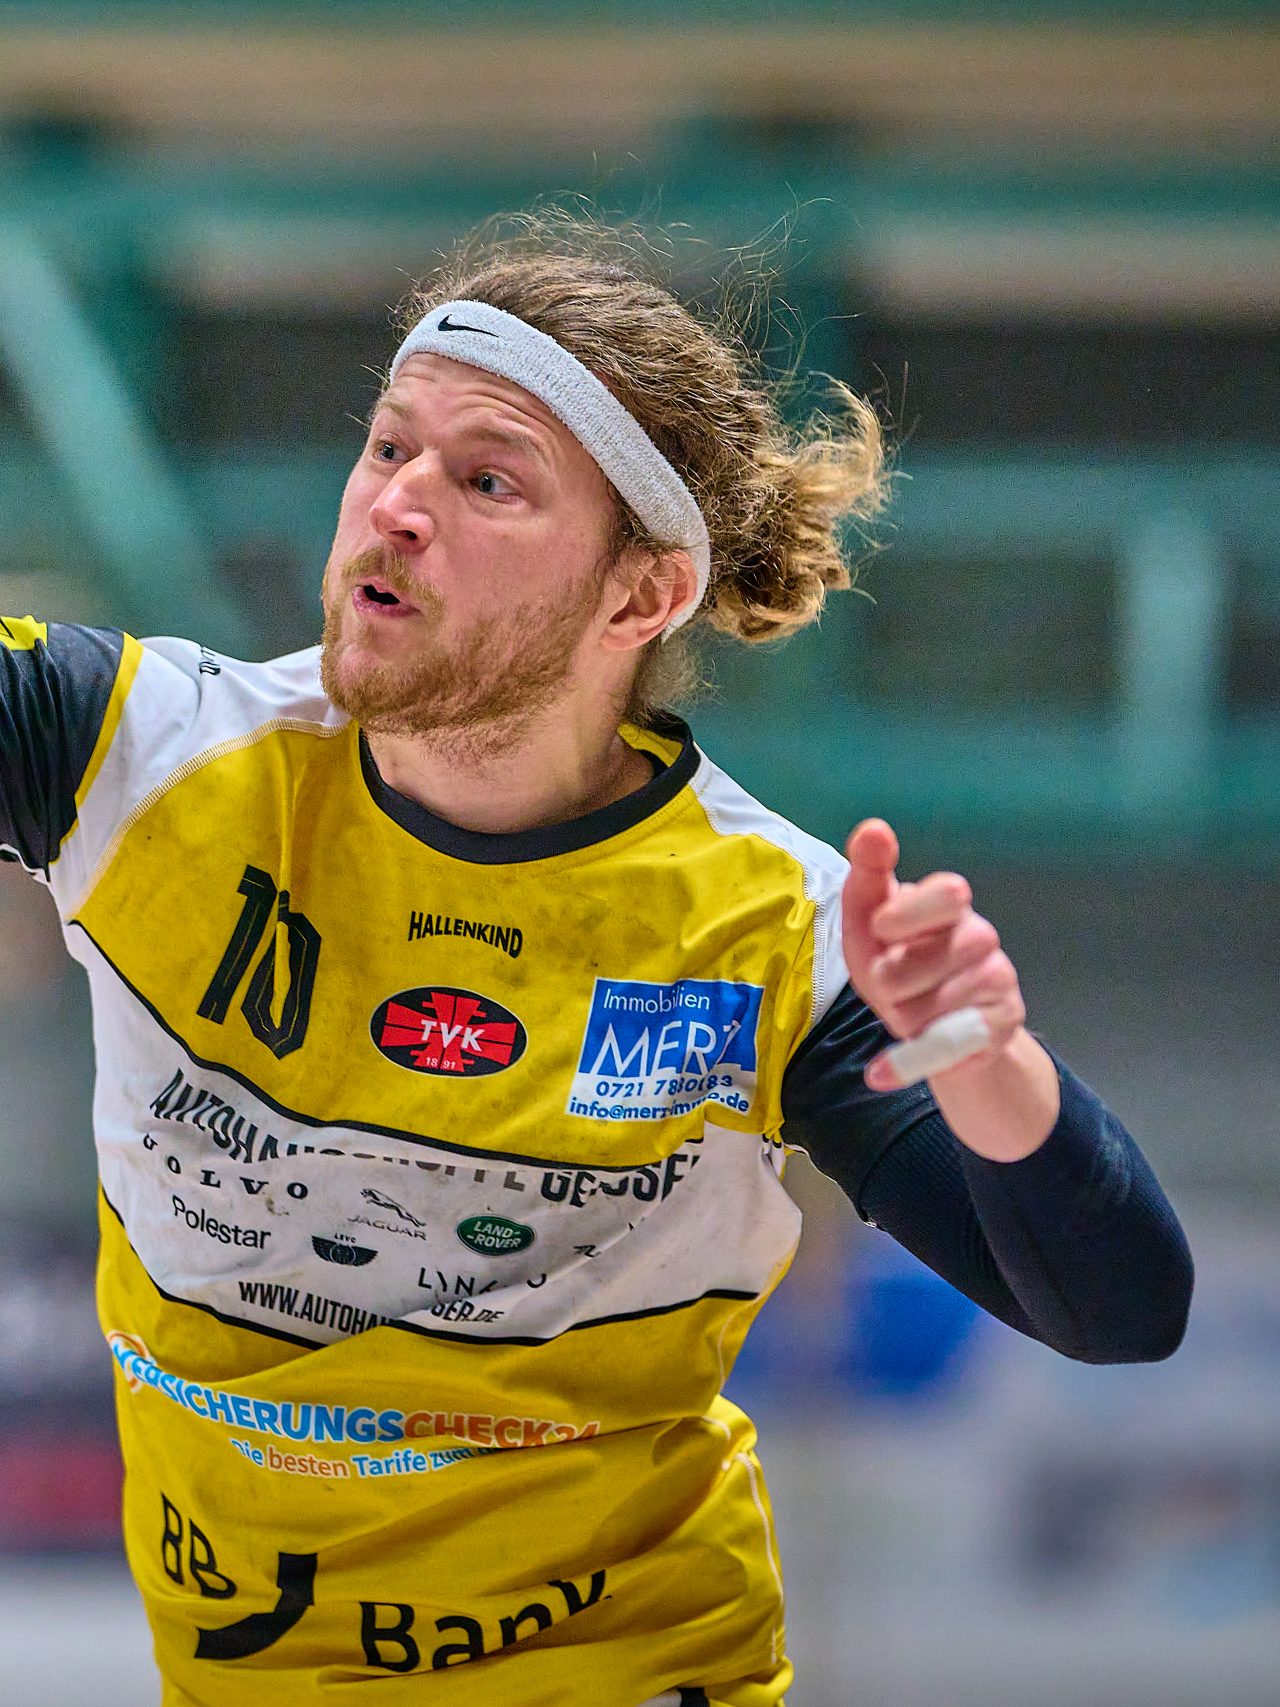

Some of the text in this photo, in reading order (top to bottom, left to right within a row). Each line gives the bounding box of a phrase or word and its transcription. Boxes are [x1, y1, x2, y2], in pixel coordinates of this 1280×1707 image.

[407, 910, 524, 959] HALLENKIND
[196, 864, 322, 1060] 10
[603, 985, 710, 1014] Immobilien
[420, 1019, 485, 1052] TVK
[595, 1081, 644, 1098] 0721
[171, 1194, 272, 1250] Polestar
[346, 1214, 428, 1241] JAGUAR
[268, 1446, 349, 1477] besten
[352, 1449, 427, 1477] Tarife
[161, 1492, 237, 1600] BB
